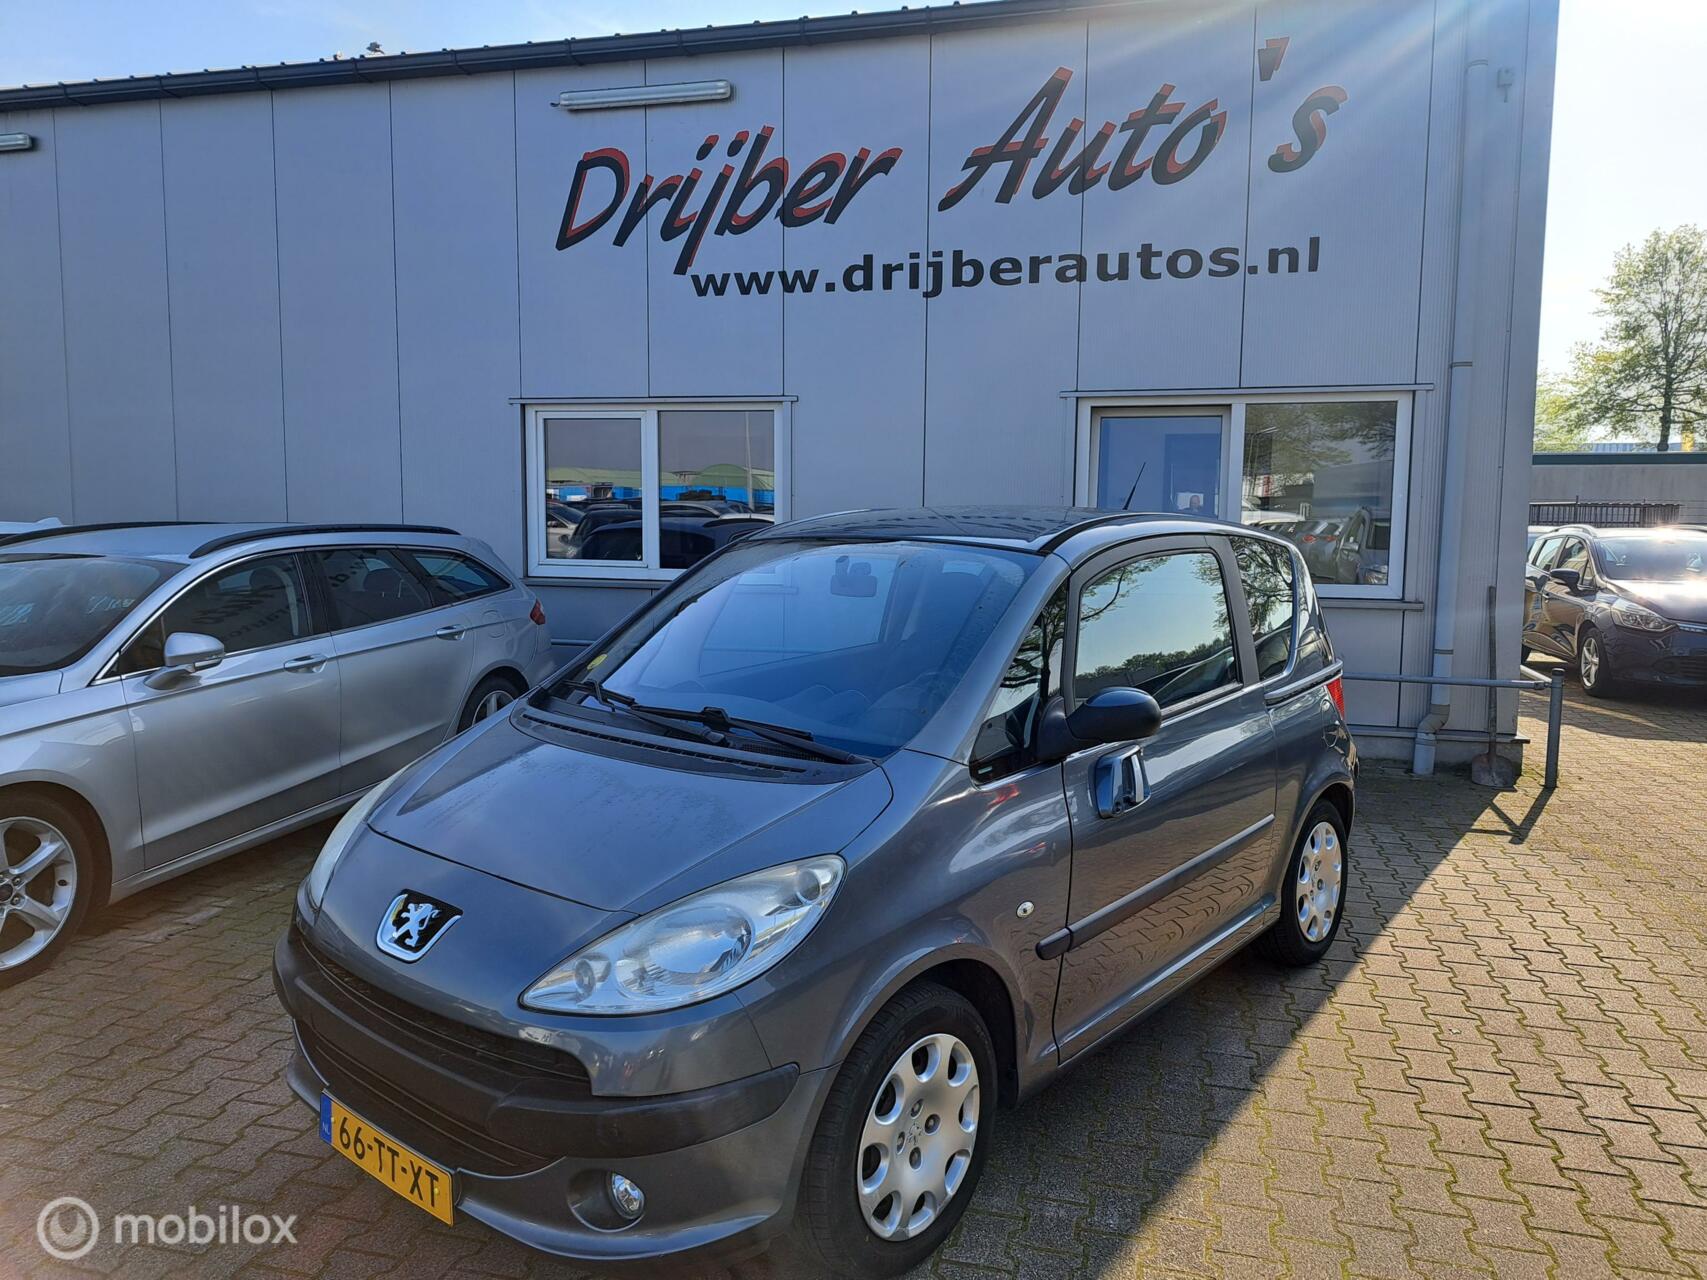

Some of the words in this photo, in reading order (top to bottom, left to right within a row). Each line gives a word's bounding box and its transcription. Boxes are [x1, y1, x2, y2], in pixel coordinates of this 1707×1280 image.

[555, 125, 903, 275] Drijber
[937, 36, 1348, 212] Auto's
[691, 236, 1320, 298] www.drijberautos.nl
[322, 1121, 330, 1136] NL
[339, 1116, 439, 1208] 66-TT-XT
